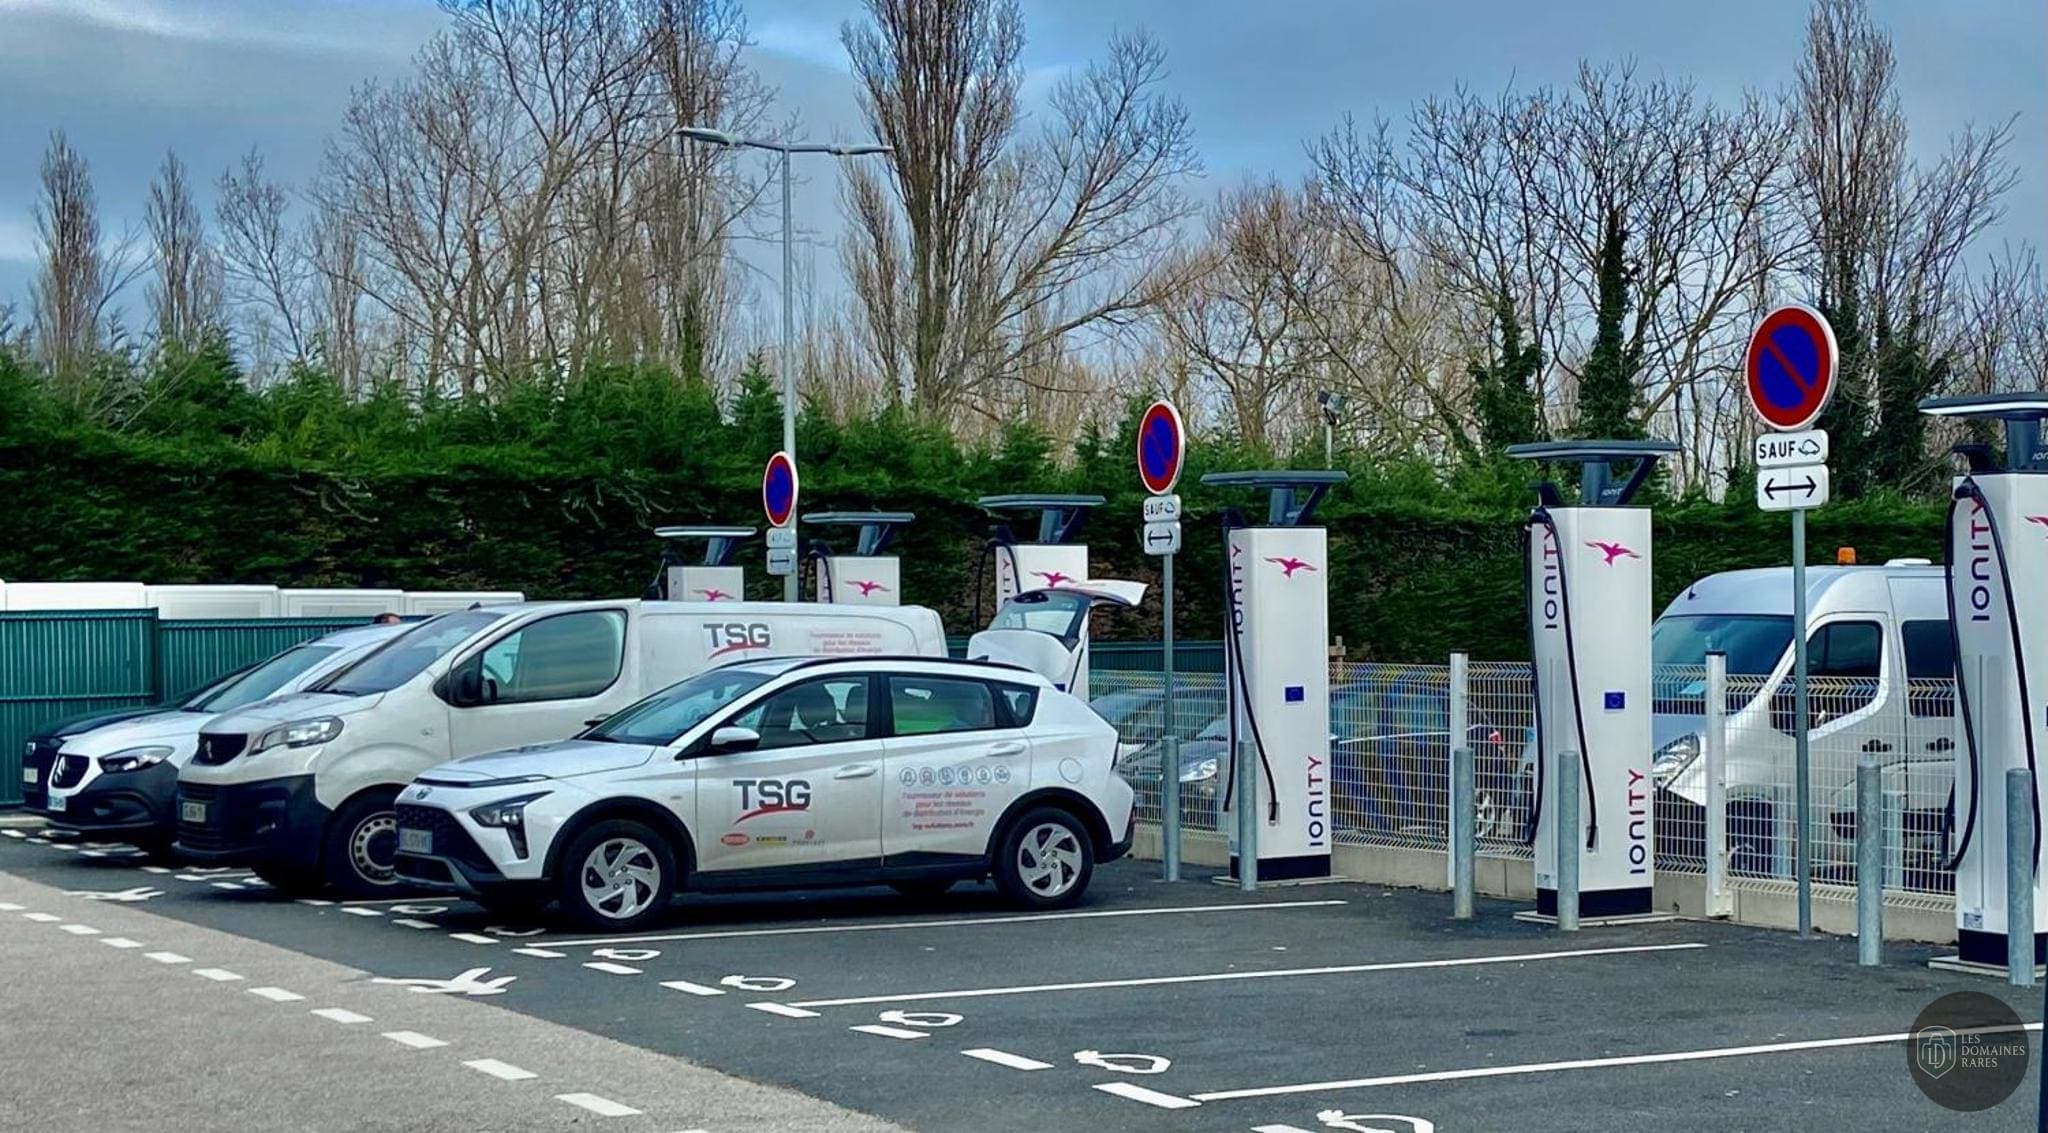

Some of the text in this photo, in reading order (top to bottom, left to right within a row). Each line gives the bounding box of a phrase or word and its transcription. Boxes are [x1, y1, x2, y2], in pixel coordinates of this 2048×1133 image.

[1759, 440, 1796, 459] SAUF
[1544, 523, 1558, 629] IONITY
[703, 623, 771, 648] TSG
[733, 780, 811, 810] TSG
[1308, 755, 1323, 847] IONITY
[1628, 769, 1645, 874] IONITY
